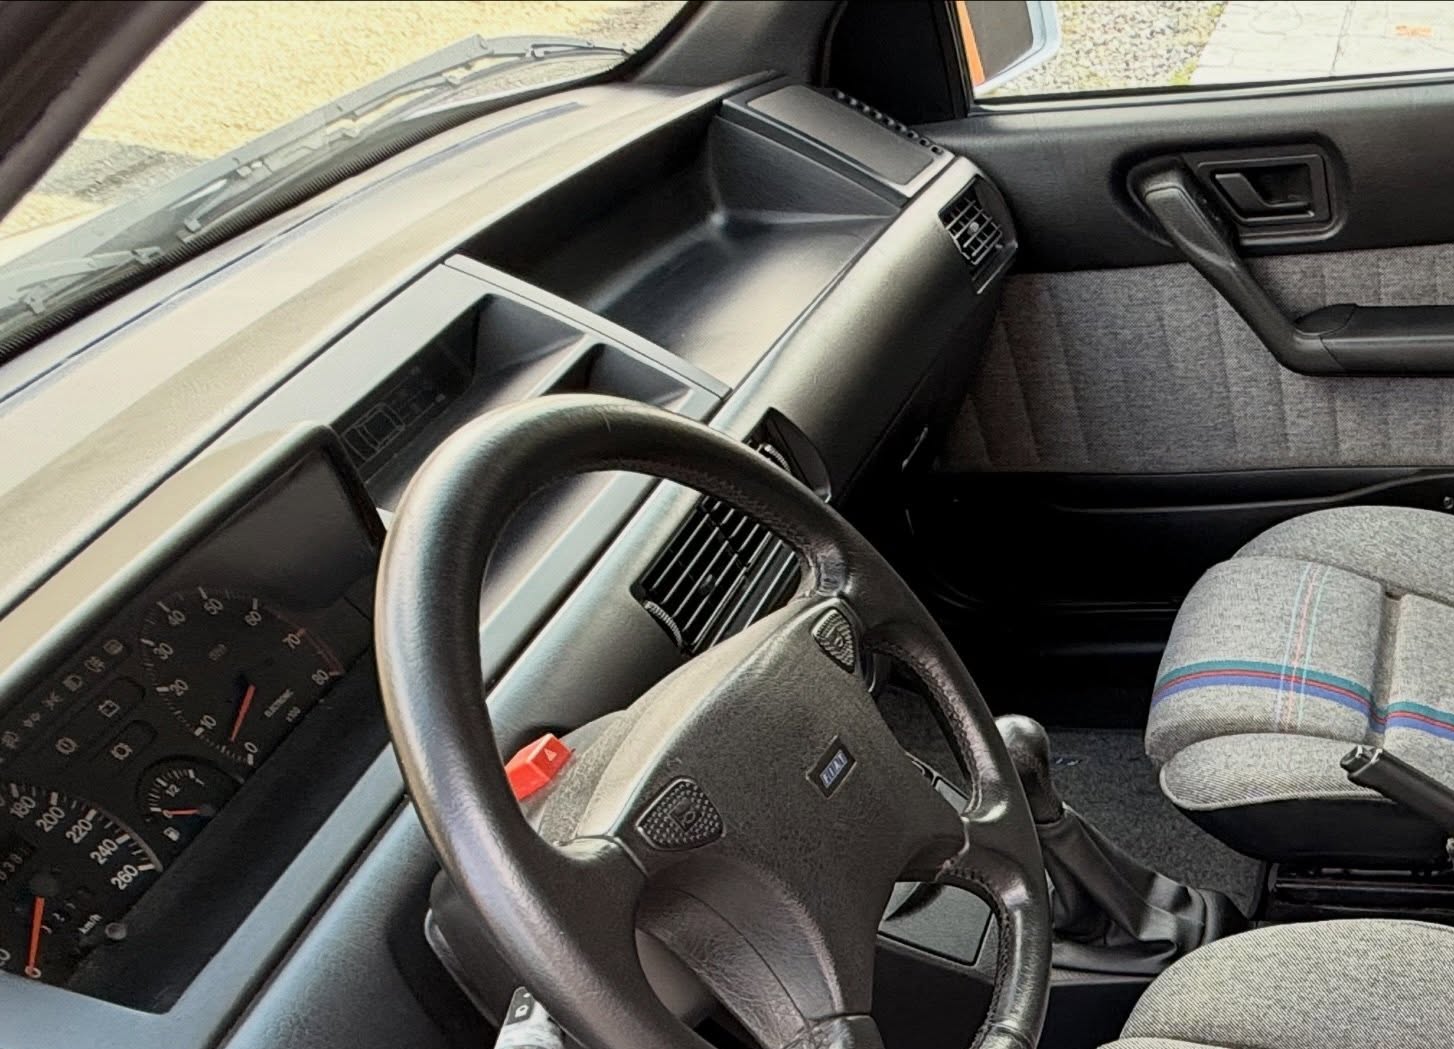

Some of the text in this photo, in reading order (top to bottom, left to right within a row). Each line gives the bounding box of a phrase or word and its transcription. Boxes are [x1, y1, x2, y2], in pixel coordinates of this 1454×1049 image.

[204, 598, 224, 615] 50
[168, 610, 186, 626] 40
[282, 632, 301, 649] 70
[153, 642, 173, 660] 30
[311, 669, 329, 686] 80
[200, 714, 217, 730] 10
[244, 741, 258, 753] 0
[821, 749, 847, 786] FIAT
[10, 795, 36, 819] 180
[36, 805, 65, 832] 200
[65, 818, 93, 844] 220
[90, 838, 118, 865] 240
[110, 864, 139, 891] 260
